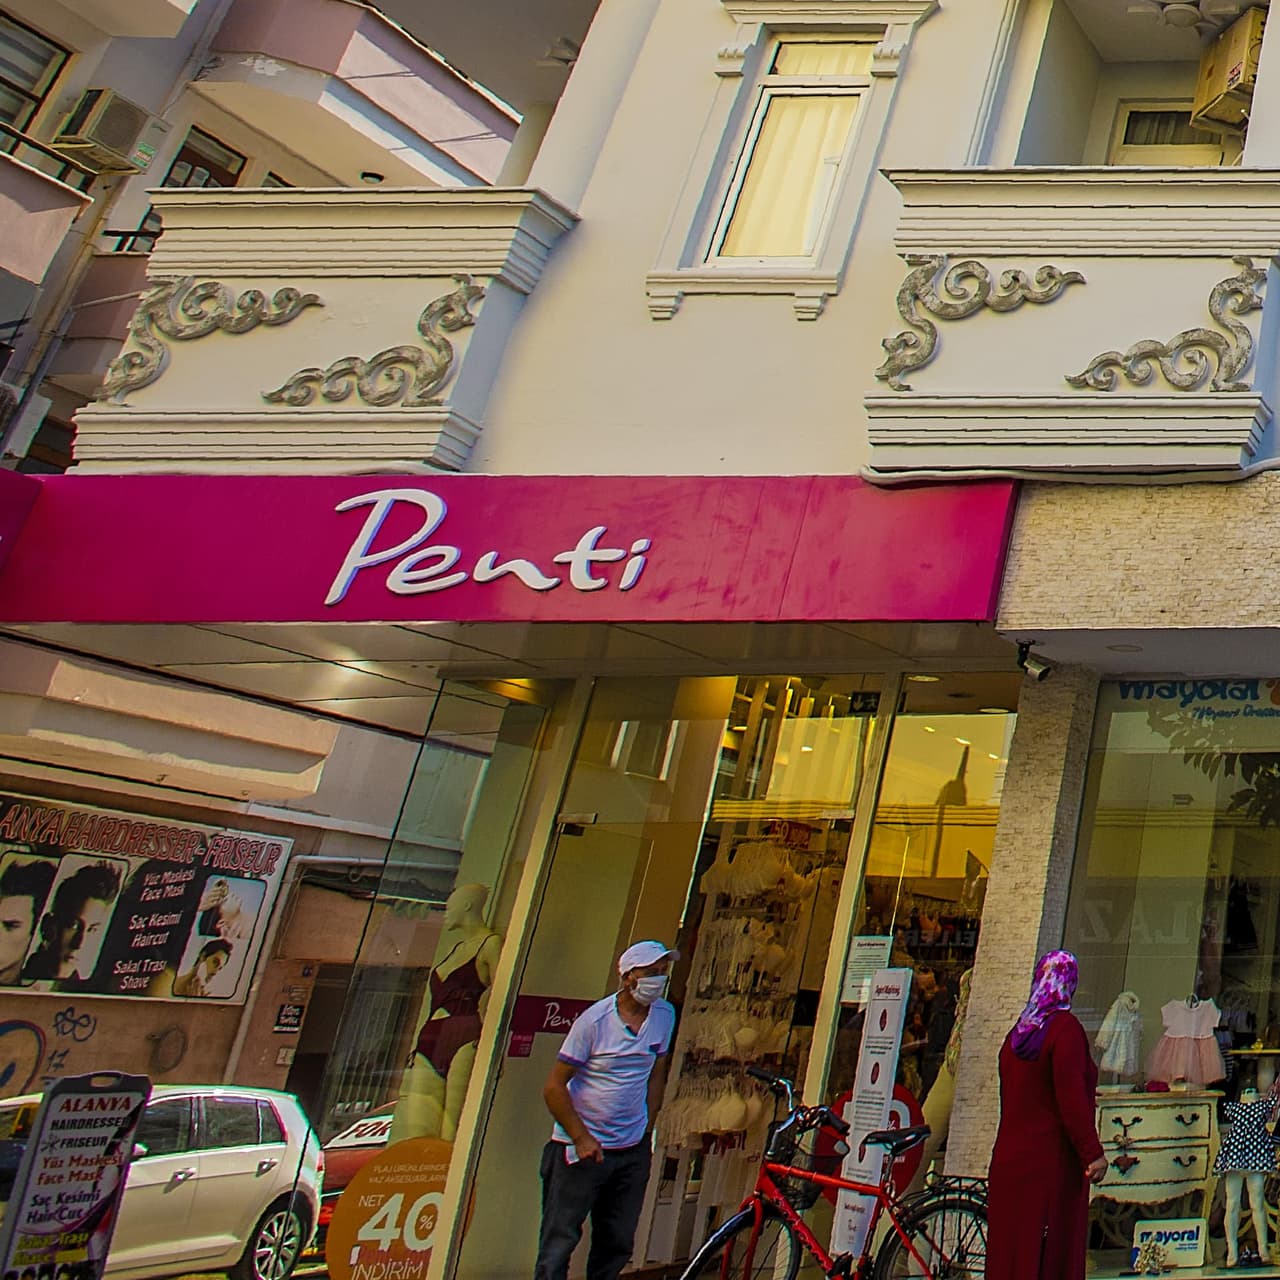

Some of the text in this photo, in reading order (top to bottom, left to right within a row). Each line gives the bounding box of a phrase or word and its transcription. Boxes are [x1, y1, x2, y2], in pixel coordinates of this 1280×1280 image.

[324, 489, 651, 605] Penti
[0, 803, 64, 847] ANYA
[141, 884, 185, 903] Face Mask
[132, 931, 170, 948] Haircut
[59, 1096, 131, 1112] ALANYA
[60, 1135, 108, 1148] FRISEUR
[42, 1156, 65, 1169] Yüz
[37, 1170, 104, 1185] Face Mask
[358, 1194, 385, 1207] NET
[357, 1191, 445, 1251] 40
[1140, 1225, 1200, 1246] mayoral
